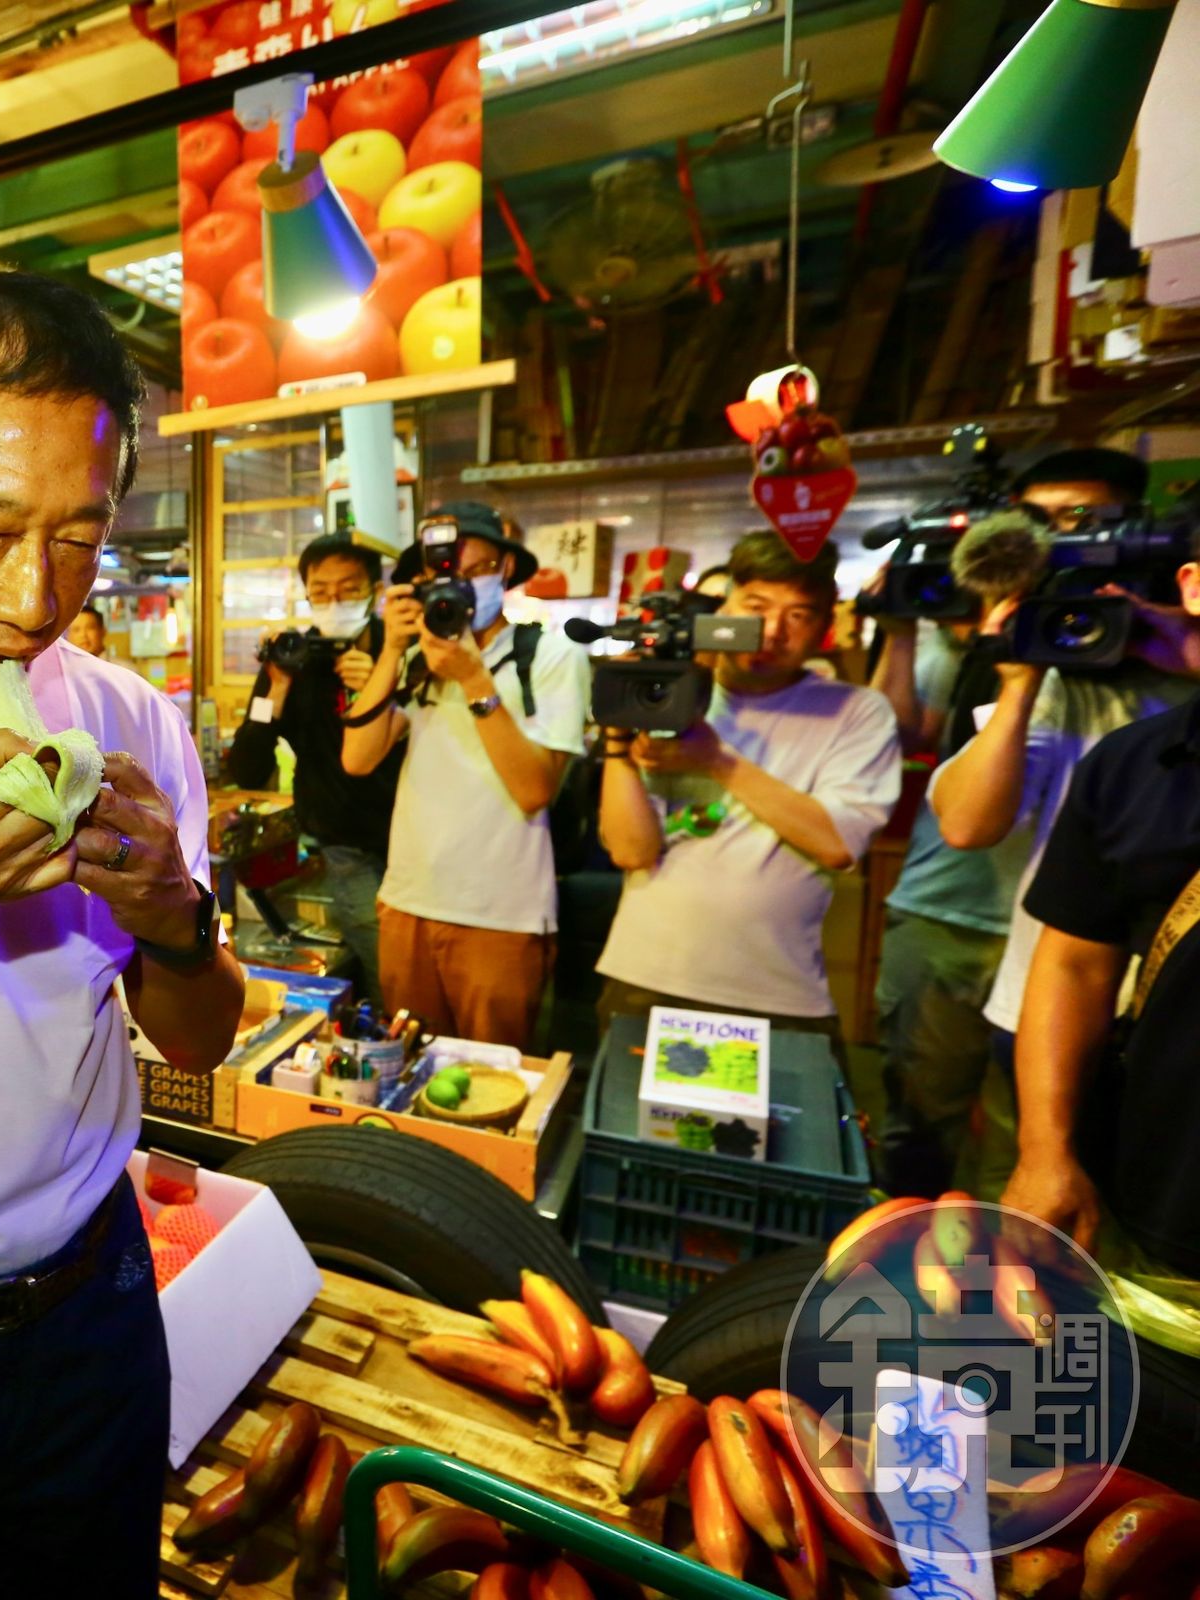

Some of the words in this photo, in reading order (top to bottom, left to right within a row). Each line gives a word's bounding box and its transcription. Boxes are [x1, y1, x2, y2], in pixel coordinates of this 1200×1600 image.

[150, 1065, 210, 1088] GRAPES
[150, 1079, 210, 1102] GRAPES
[150, 1094, 210, 1117] GRAPES
